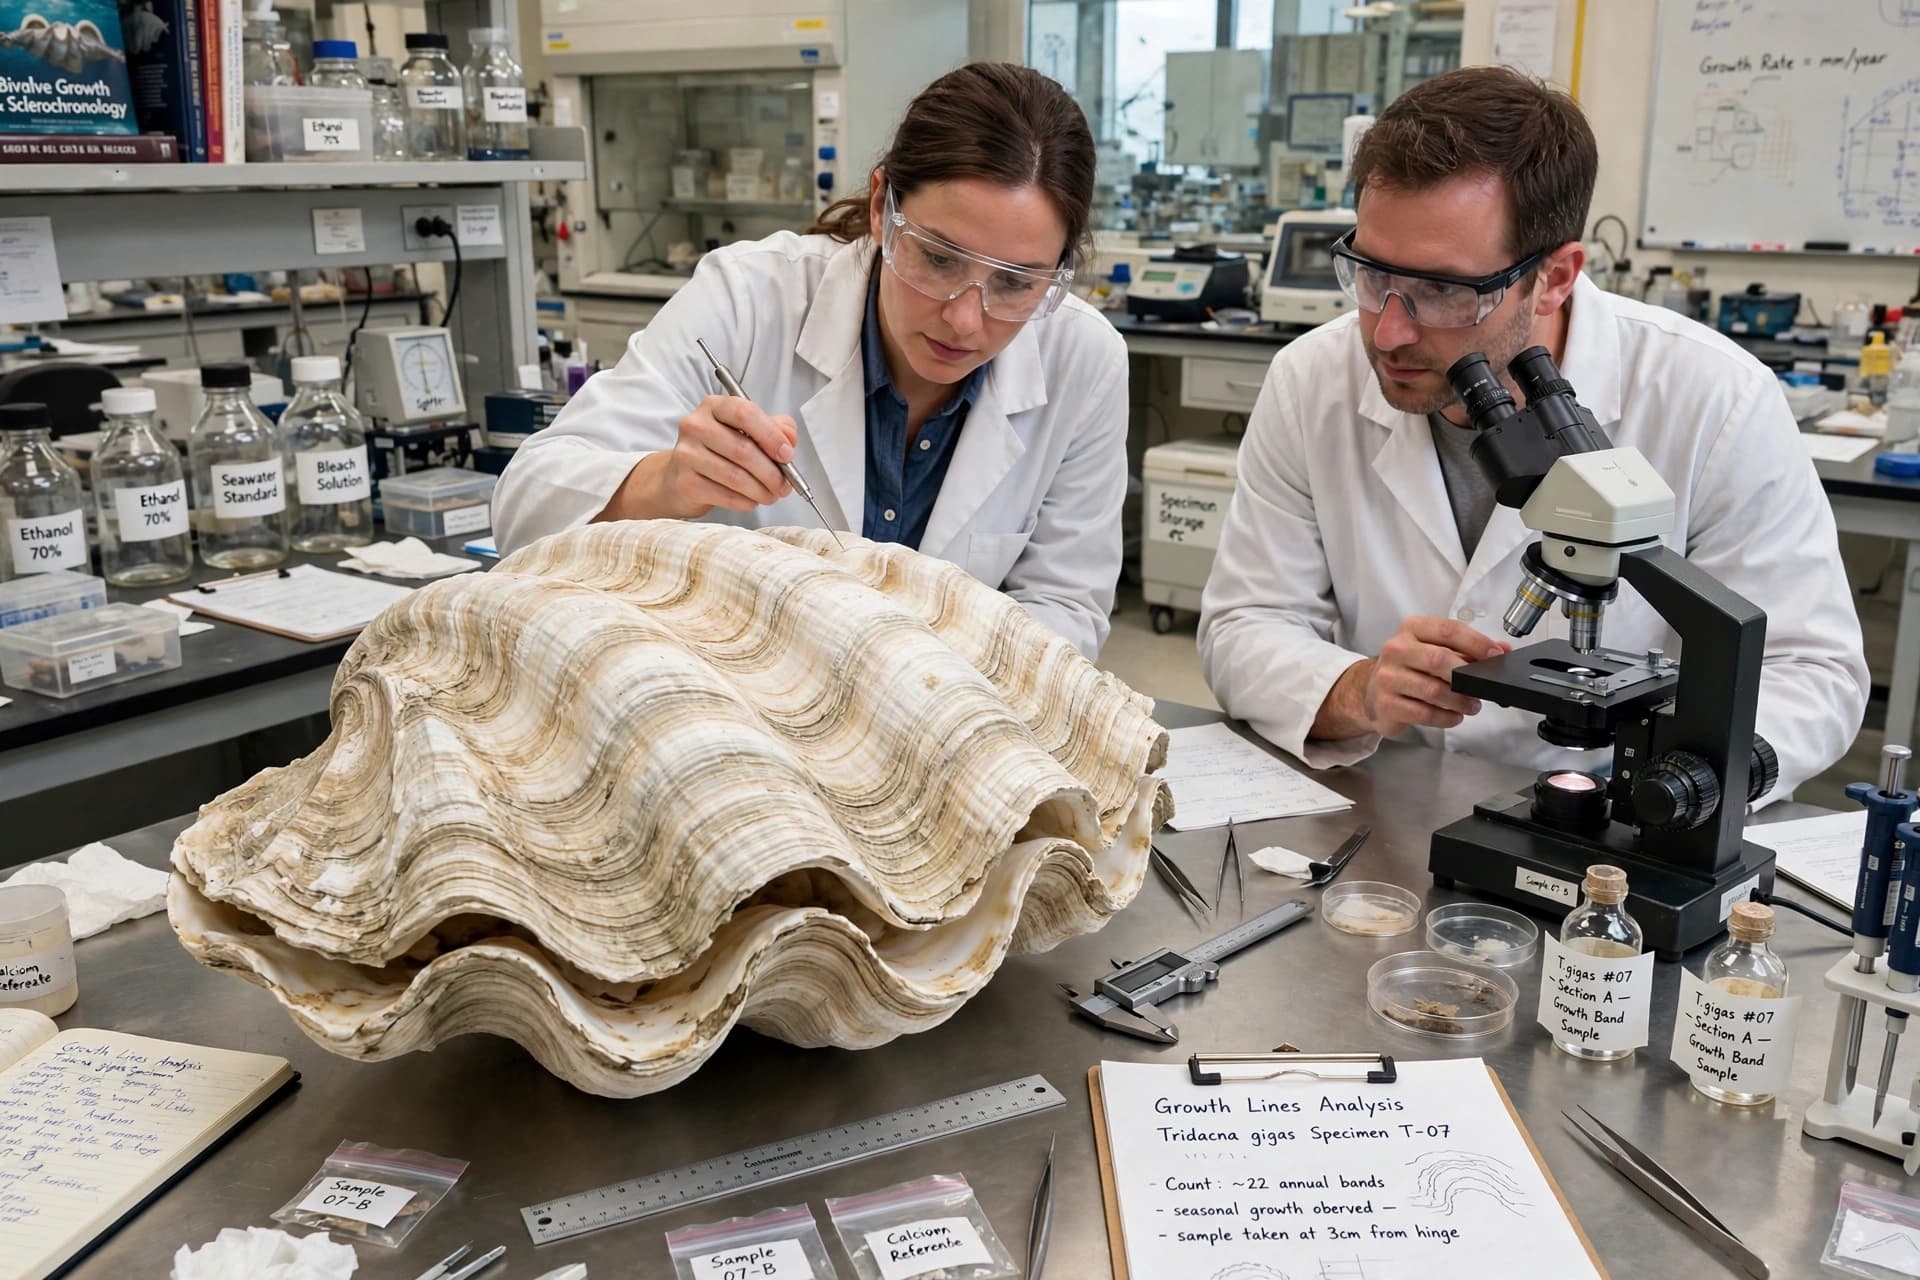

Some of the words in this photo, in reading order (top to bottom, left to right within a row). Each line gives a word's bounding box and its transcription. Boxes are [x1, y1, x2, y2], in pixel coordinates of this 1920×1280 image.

[1700, 55, 1751, 75] Growth
[1760, 53, 1794, 71] Rate
[1820, 48, 1887, 73] mm/year
[55, 78, 111, 97] Growth
[6, 95, 127, 119] Sclerochronology
[312, 121, 343, 132] Ethanol
[317, 458, 356, 474] Bleach
[222, 470, 277, 487] Seawater
[317, 475, 363, 491] Solution
[140, 488, 180, 507] Ethanol
[224, 484, 278, 503] Standard
[144, 511, 171, 526] 70%
[20, 522, 73, 541] Ethanol
[30, 544, 62, 560] 70%
[1558, 955, 1596, 983] T.gigas
[1603, 970, 1633, 983] #07
[1557, 979, 1596, 1002] Section
[1603, 991, 1613, 1003] A
[1553, 996, 1588, 1021] Growth
[1594, 1011, 1625, 1024] Band
[1695, 991, 1735, 1020] T.gigas
[1743, 1011, 1775, 1024] #07
[1561, 1019, 1600, 1042] Sample
[1694, 1016, 1735, 1042] Section
[1742, 1031, 1753, 1045] A
[1689, 1033, 1725, 1060] Growth
[1732, 1050, 1765, 1067] Band
[1696, 1057, 1738, 1082] Sample
[1154, 1097, 1231, 1114] Growth
[1248, 1097, 1301, 1112] Lines
[1319, 1096, 1404, 1118] Analysis
[1157, 1127, 1239, 1142] Tridacna
[1251, 1129, 1296, 1147] gigas
[1310, 1126, 1390, 1144] Specimen
[1398, 1124, 1450, 1138] T-07
[330, 1180, 386, 1197] Sample
[1232, 1177, 1270, 1190] ~22
[1279, 1175, 1329, 1189] annual
[1339, 1174, 1385, 1188] bands
[323, 1195, 372, 1210] 07-B
[1173, 1201, 1239, 1216] seasonal
[1250, 1201, 1303, 1221] growth
[1313, 1200, 1373, 1214] oberved
[1177, 1227, 1233, 1246] sample
[1242, 1227, 1289, 1241] taken
[1299, 1226, 1317, 1240] at
[1327, 1226, 1361, 1240] 3cm
[1370, 1224, 1407, 1239] from
[1415, 1224, 1460, 1244] hinge
[711, 1248, 776, 1269] Sample
[724, 1263, 776, 1280] 07-B
